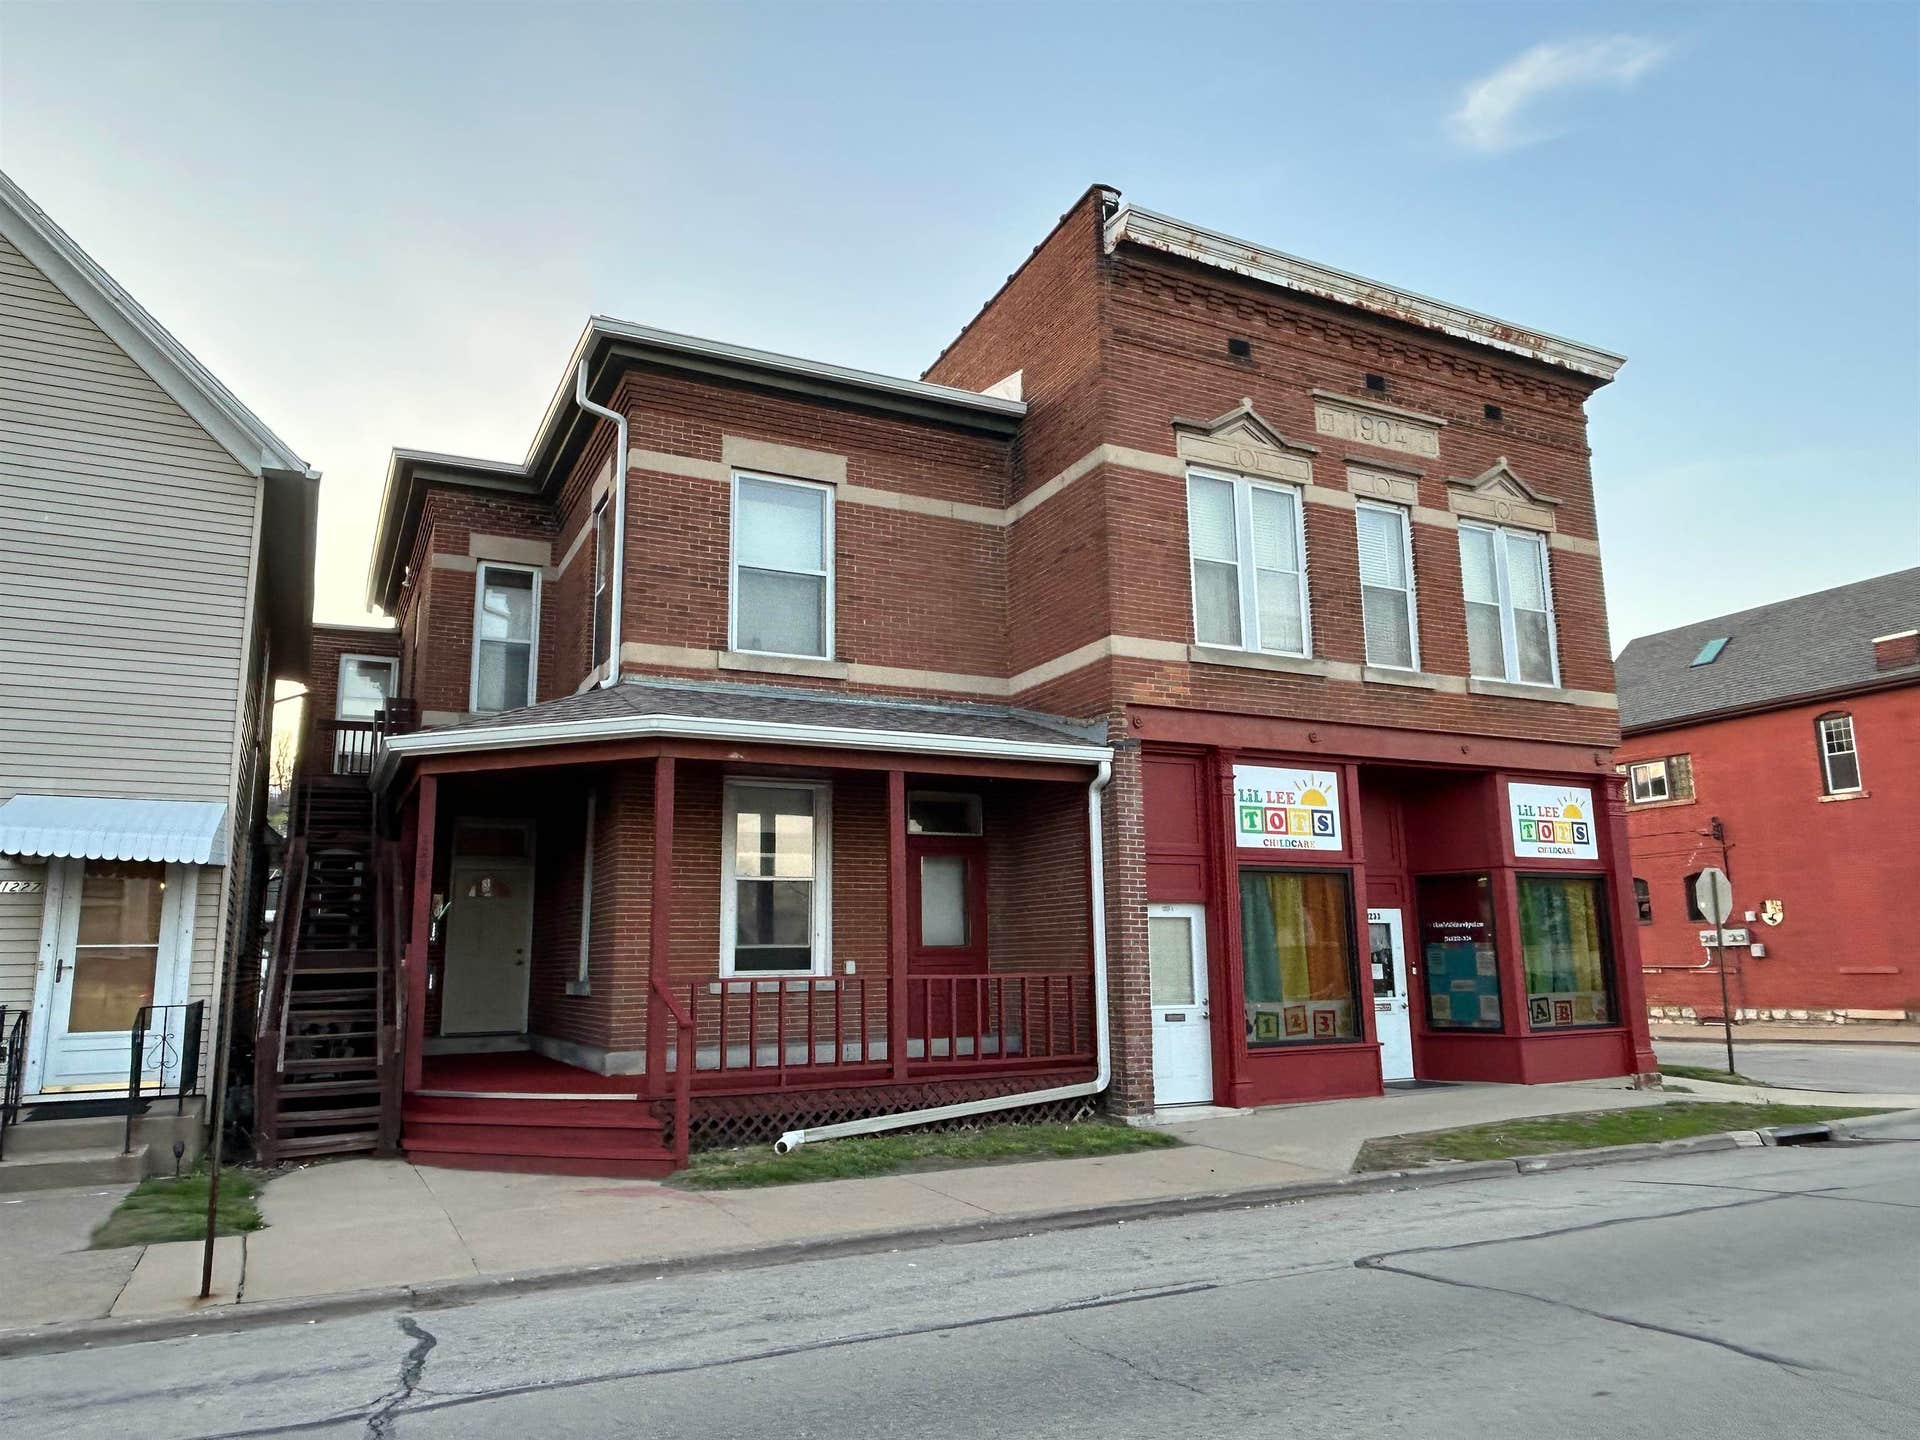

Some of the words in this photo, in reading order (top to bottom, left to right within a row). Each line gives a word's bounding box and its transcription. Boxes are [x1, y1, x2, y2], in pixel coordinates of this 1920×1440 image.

[1266, 790, 1297, 805] LEE
[1537, 805, 1560, 818] LEE
[1243, 810, 1331, 833] TOTS
[1522, 823, 1586, 841] TOTS
[1263, 838, 1317, 849] CHILDCARE
[1535, 1002, 1548, 1020] A
[1263, 1018, 1273, 1034] 1
[1319, 1015, 1330, 1032] 3
